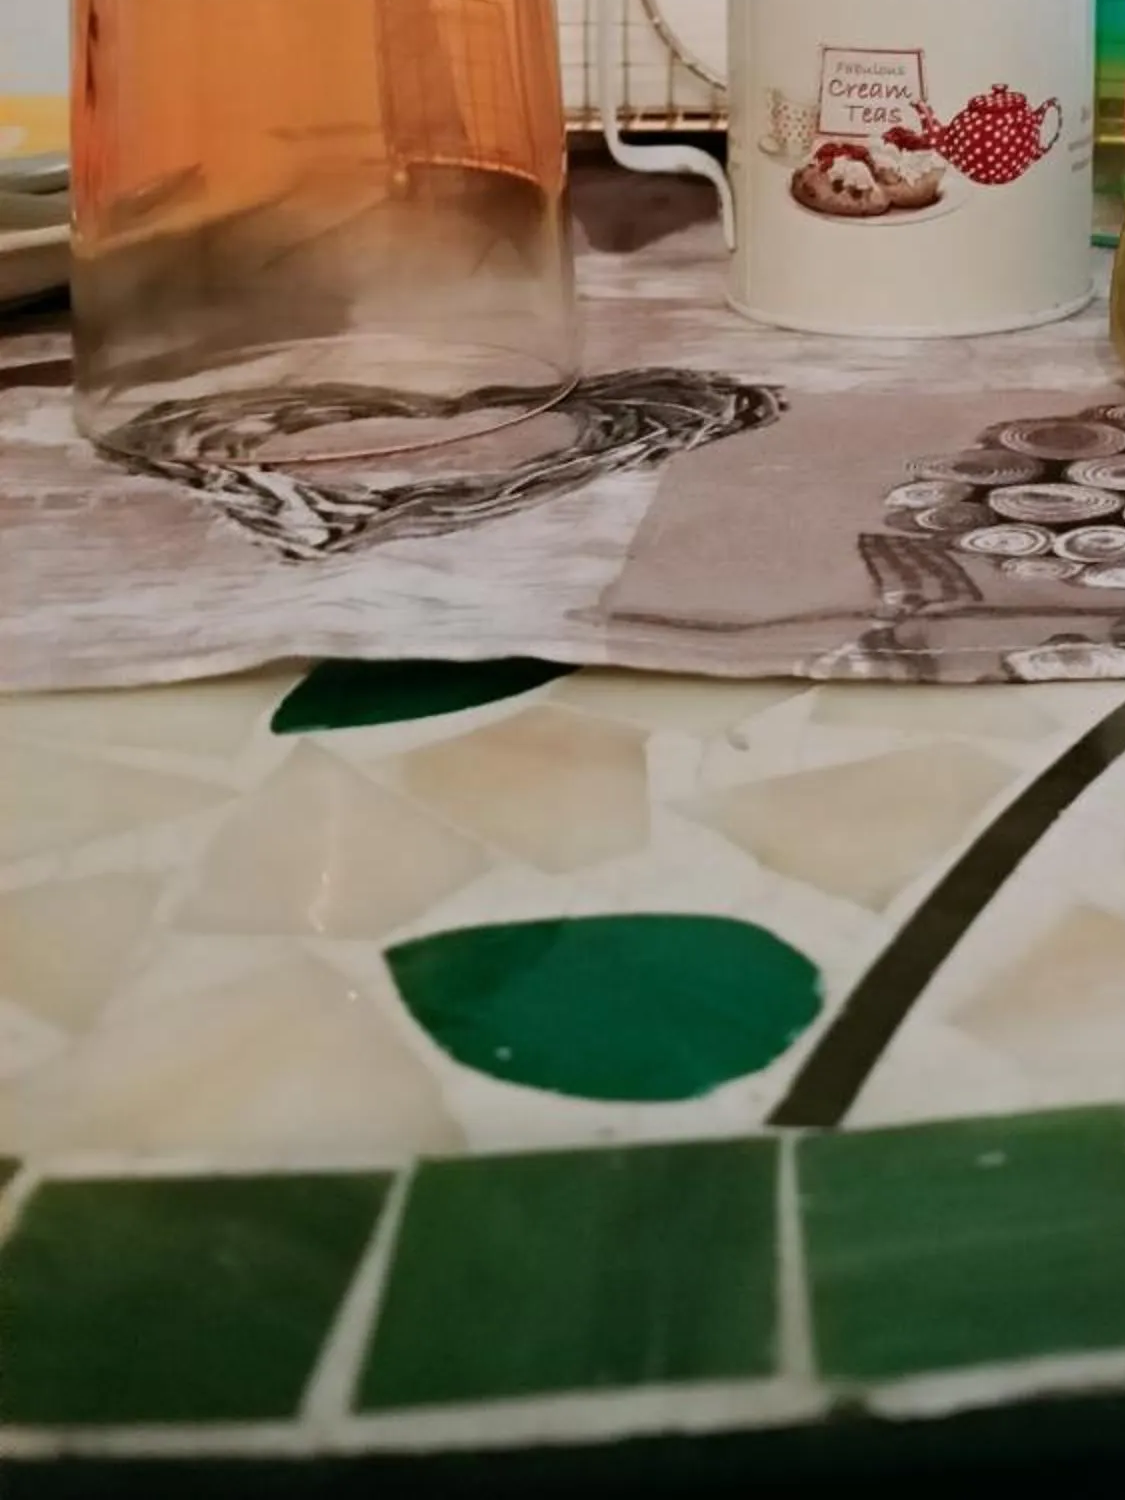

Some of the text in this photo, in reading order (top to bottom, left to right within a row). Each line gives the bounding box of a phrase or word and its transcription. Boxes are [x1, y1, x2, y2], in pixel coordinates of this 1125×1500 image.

[835, 62, 906, 76] Fabulous
[829, 79, 912, 99] Cream
[844, 105, 903, 123] Teas
